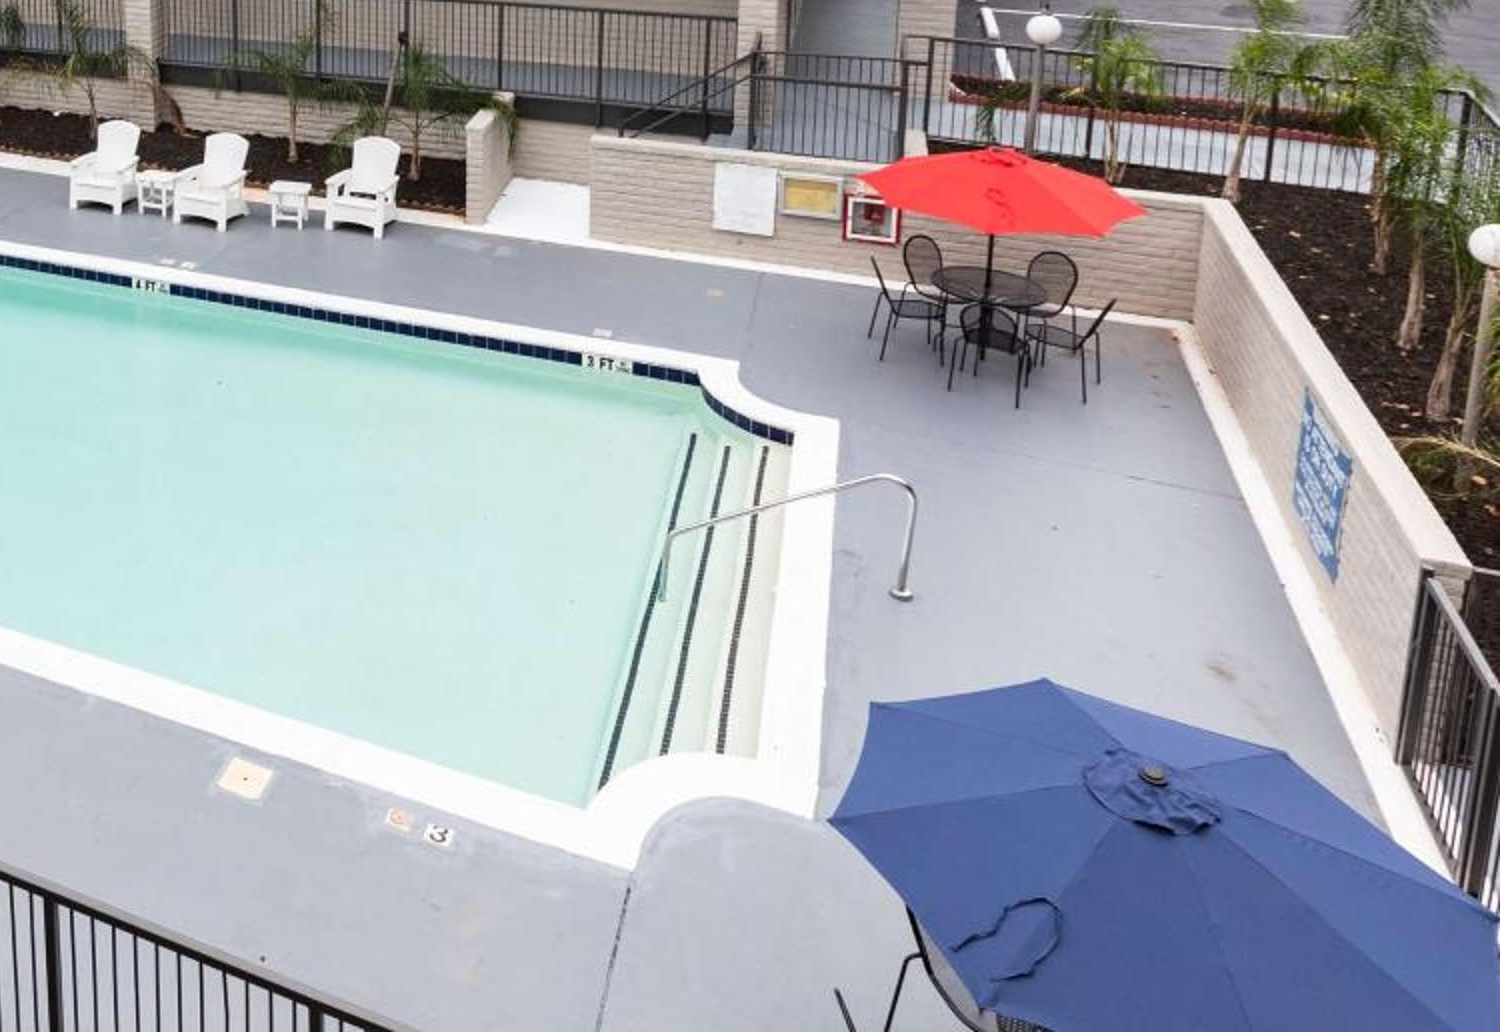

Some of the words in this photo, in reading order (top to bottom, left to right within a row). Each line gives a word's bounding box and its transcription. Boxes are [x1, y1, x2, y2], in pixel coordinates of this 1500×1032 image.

[145, 279, 157, 292] FT
[587, 354, 595, 368] 3
[599, 357, 615, 371] FT
[429, 825, 450, 843] 3
